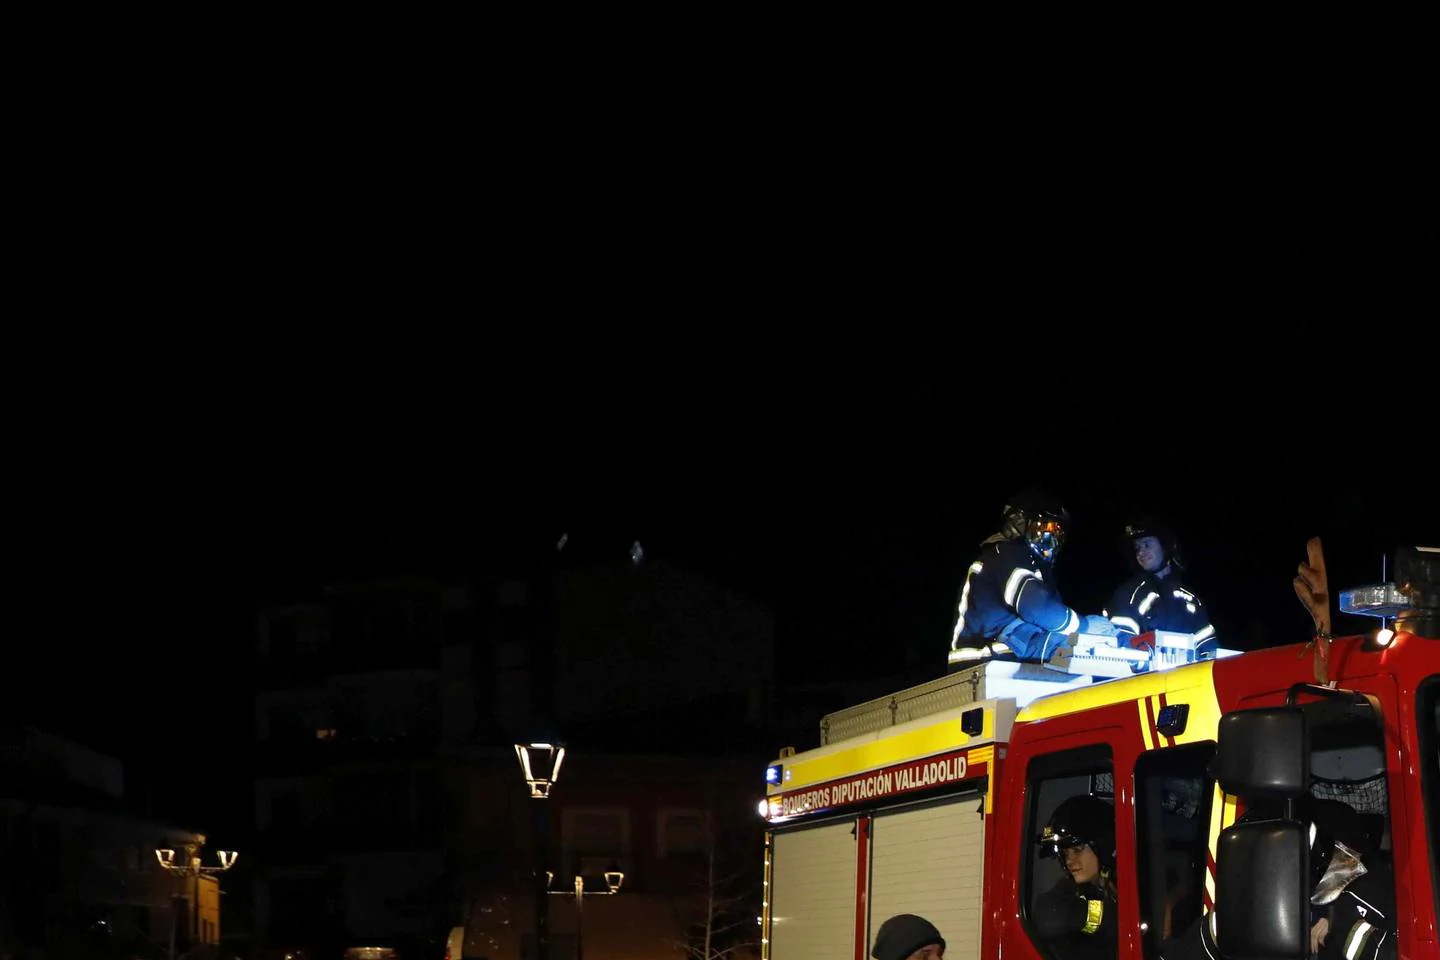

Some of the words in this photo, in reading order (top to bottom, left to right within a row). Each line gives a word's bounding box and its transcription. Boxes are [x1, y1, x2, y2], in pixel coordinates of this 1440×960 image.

[782, 788, 830, 816] BOMBEROS
[832, 770, 892, 805] DIPUTACIÓN
[894, 756, 967, 791] VALLADOLID
